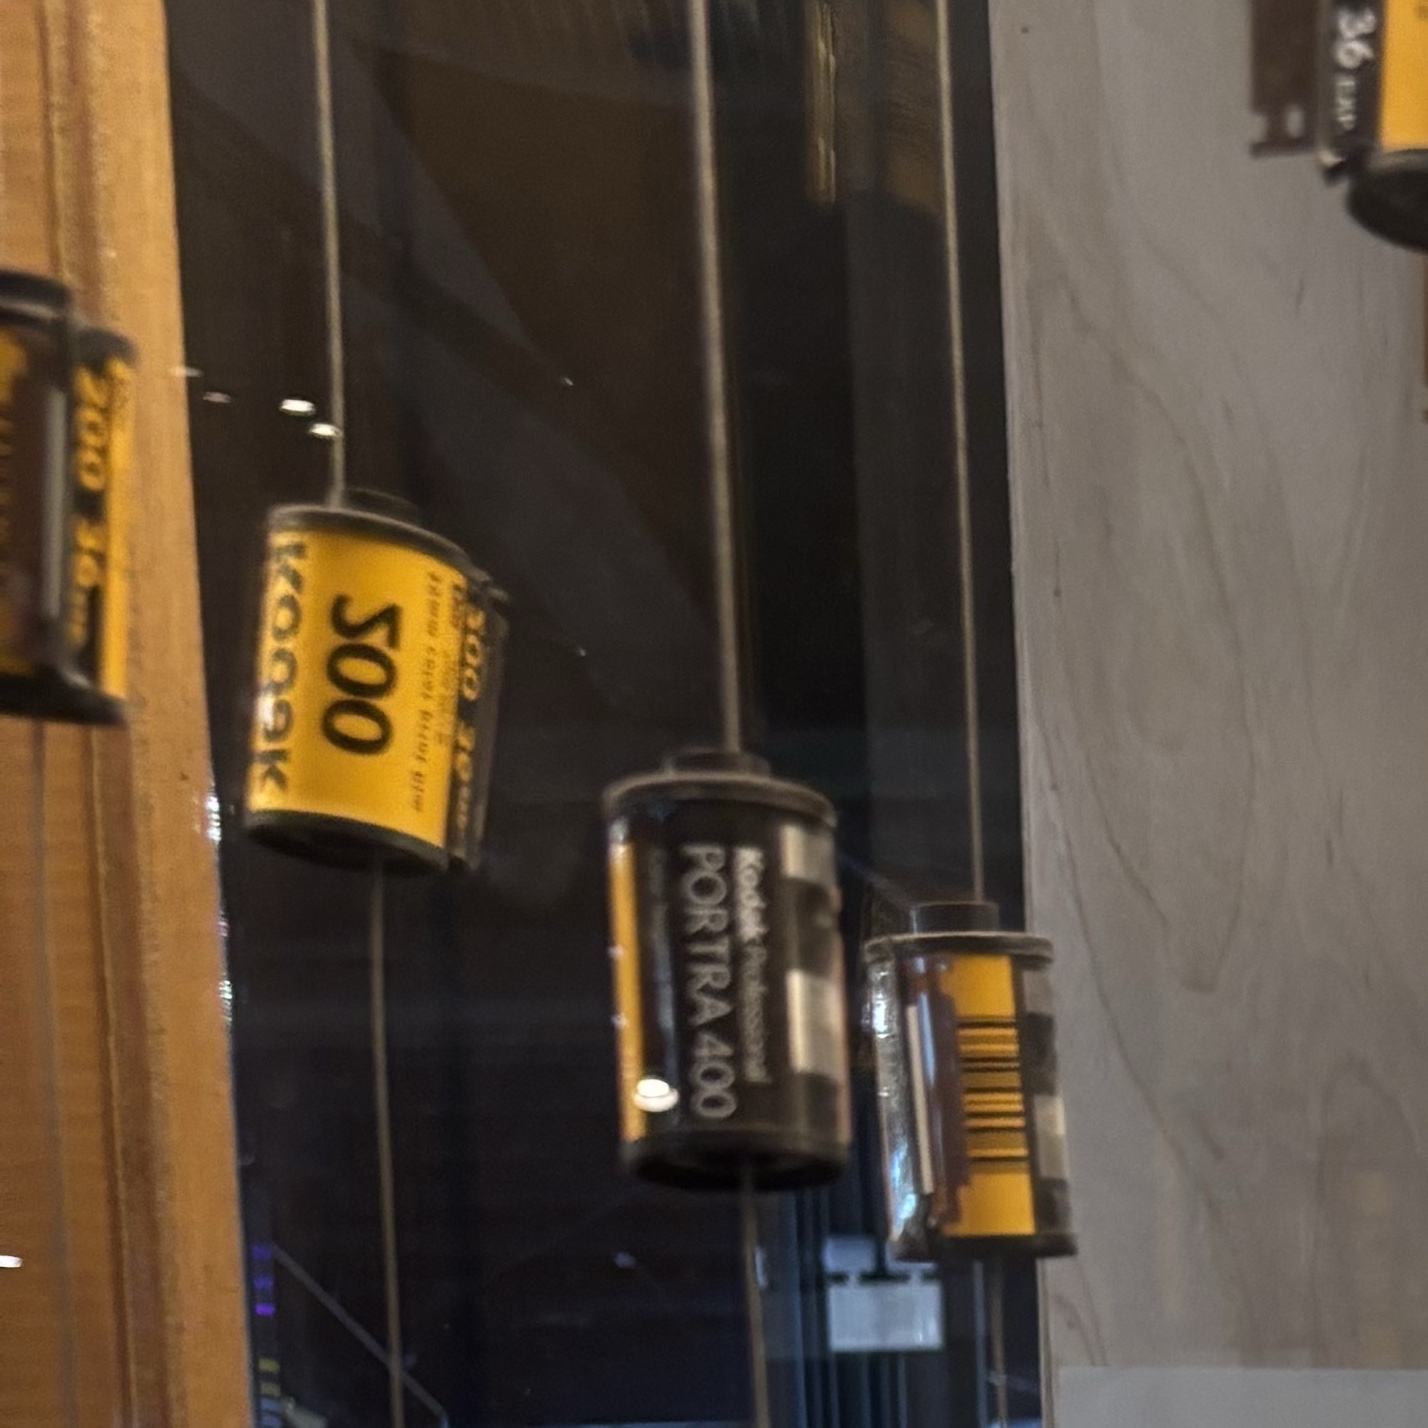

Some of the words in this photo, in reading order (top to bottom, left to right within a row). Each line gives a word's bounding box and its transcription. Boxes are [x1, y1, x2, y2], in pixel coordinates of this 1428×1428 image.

[1335, 8, 1377, 69] 36
[681, 844, 733, 1025] PORTRA
[688, 1033, 738, 1120] 400
